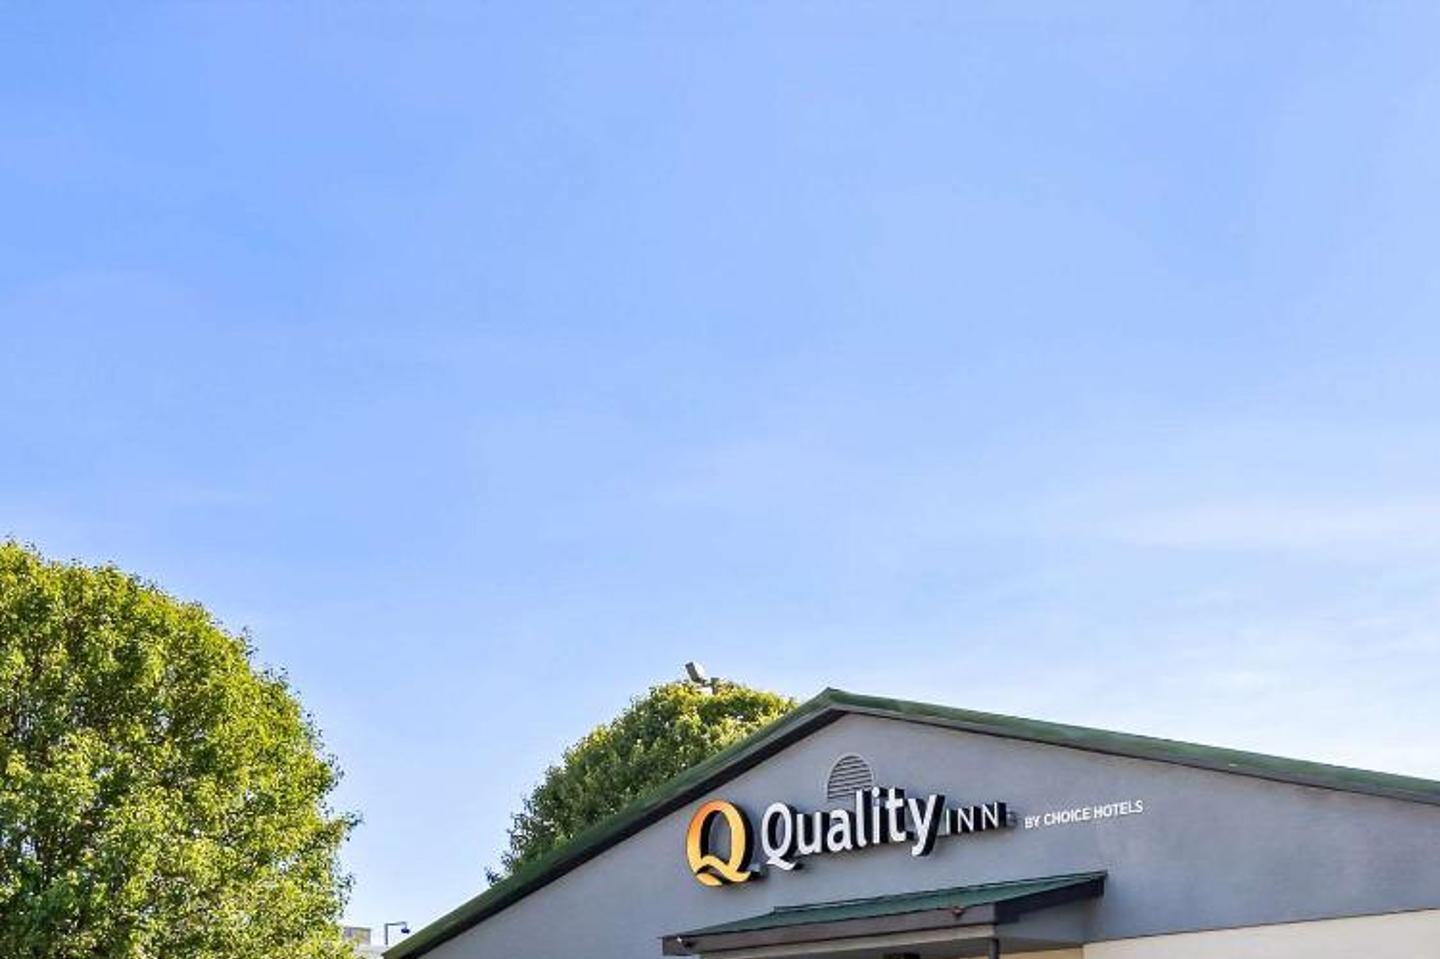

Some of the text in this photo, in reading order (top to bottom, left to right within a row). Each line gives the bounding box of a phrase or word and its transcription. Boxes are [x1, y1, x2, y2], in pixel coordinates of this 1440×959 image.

[686, 787, 1144, 886] Q Quality INN BY CHOICE HOTELS
